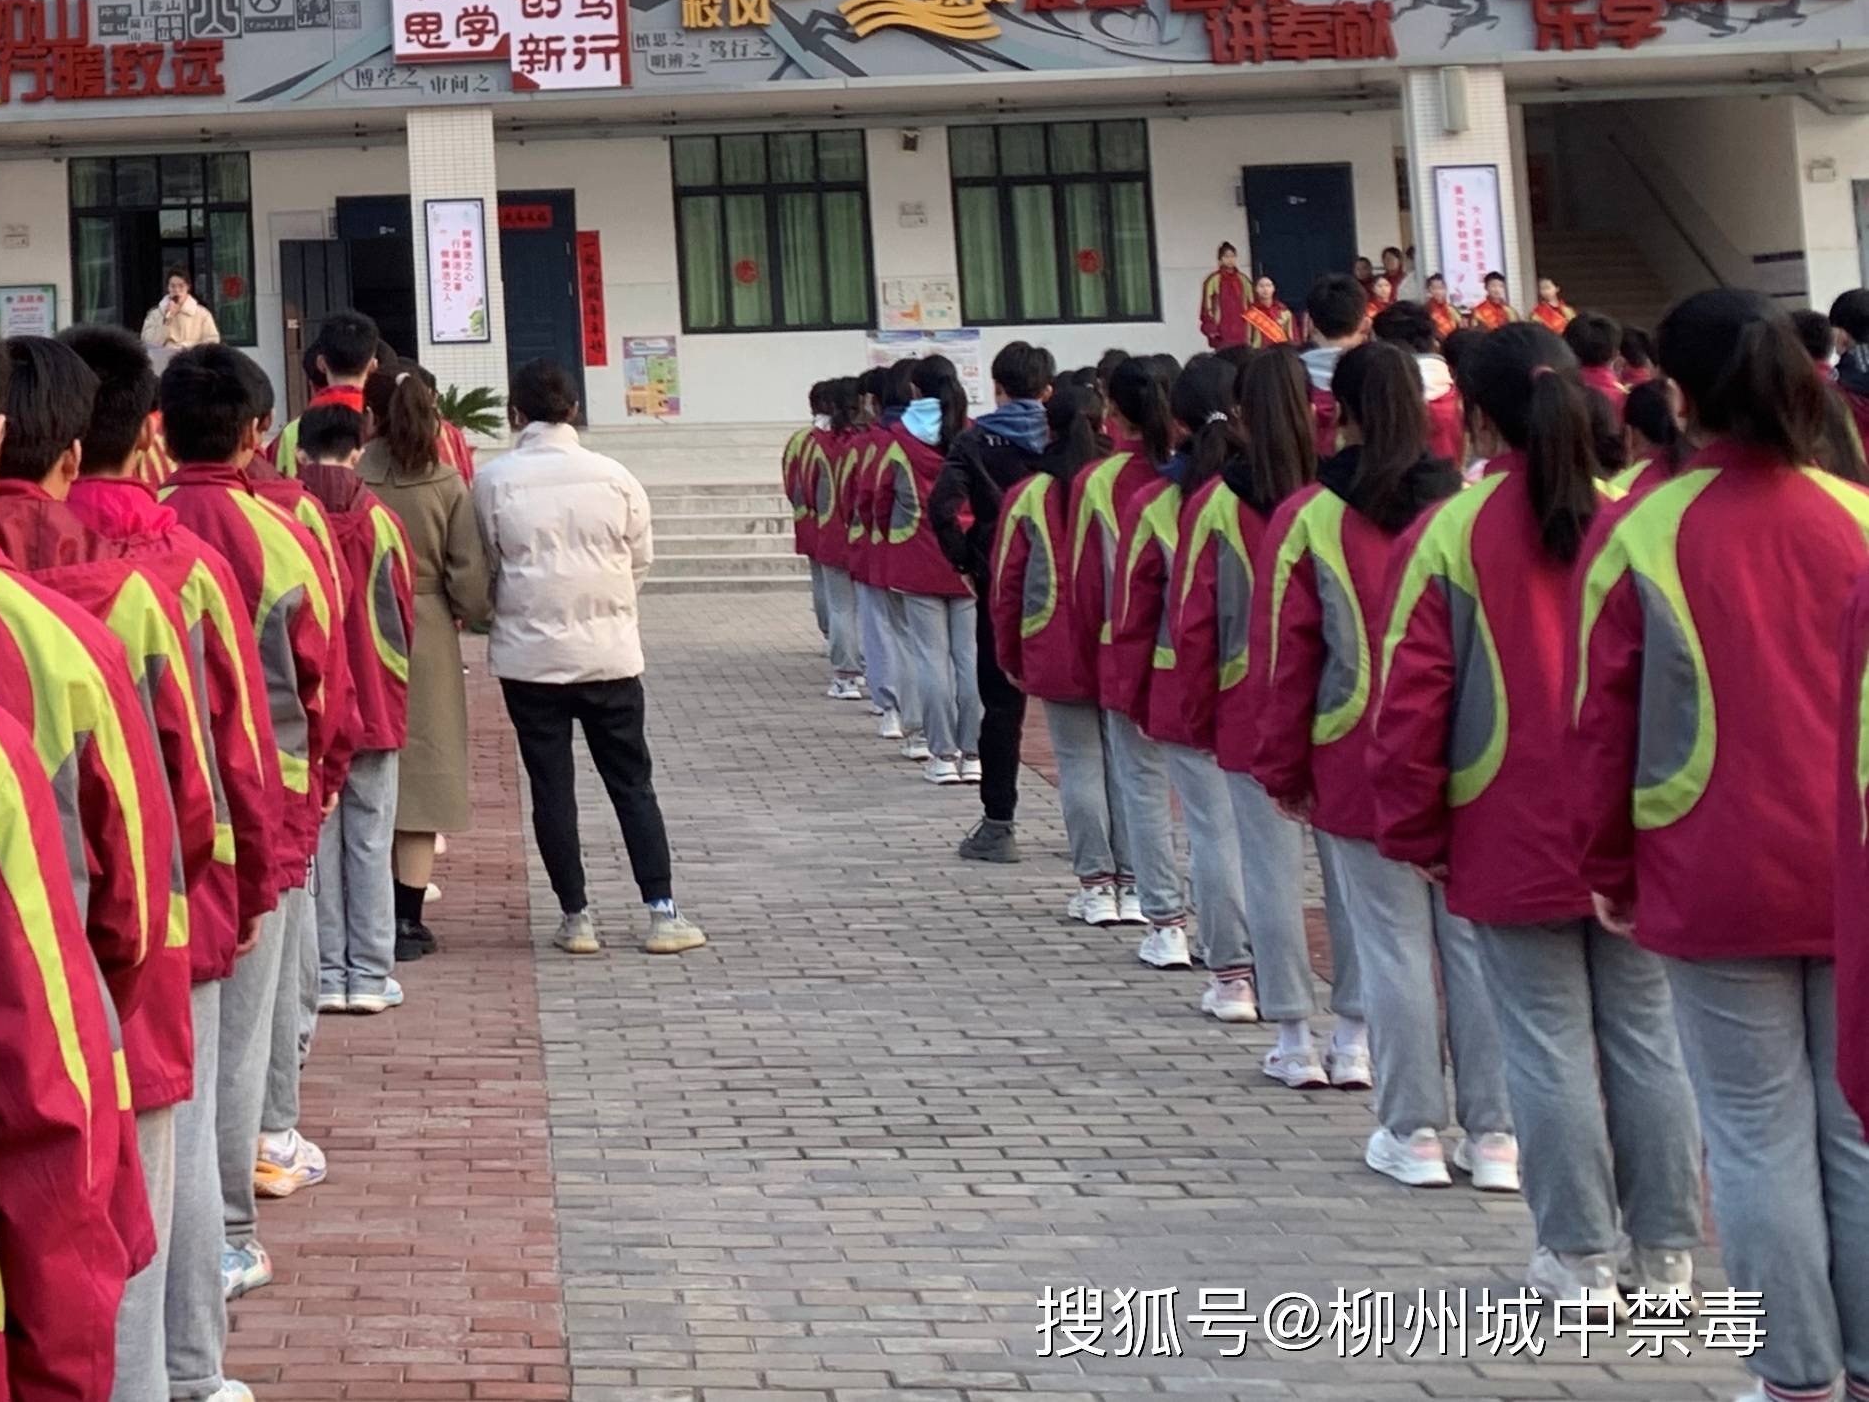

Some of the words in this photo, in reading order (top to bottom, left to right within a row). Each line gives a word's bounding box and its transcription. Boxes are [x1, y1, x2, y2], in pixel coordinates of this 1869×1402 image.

[1204, 0, 1397, 65] 讲奉献
[710, 38, 772, 58] 笃行之
[356, 66, 419, 88] 博学之
